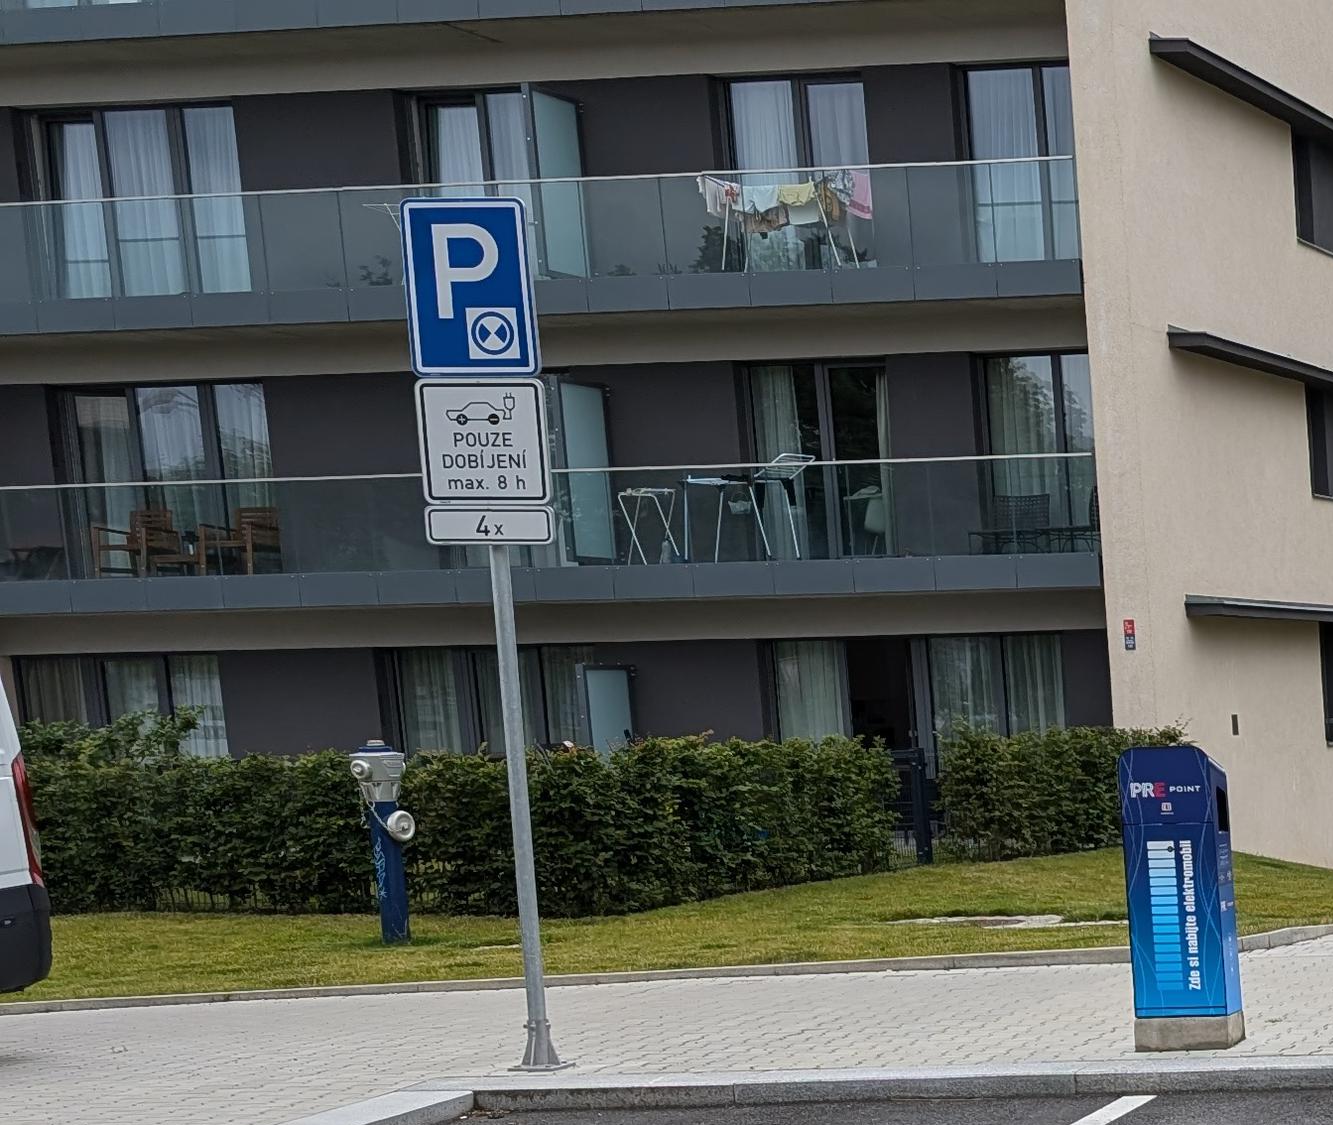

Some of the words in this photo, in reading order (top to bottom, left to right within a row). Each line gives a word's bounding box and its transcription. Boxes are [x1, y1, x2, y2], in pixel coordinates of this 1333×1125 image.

[430, 223, 499, 319] P
[453, 432, 513, 447] POUZE
[442, 449, 527, 469] DOBÍJENÍ
[448, 478, 489, 490] max.
[497, 475, 508, 490] 8
[516, 475, 527, 490] h
[1129, 782, 1166, 798] PRE
[1169, 785, 1201, 793] POINT
[1179, 840, 1196, 912] elektromobil
[1187, 969, 1201, 991] Zde
